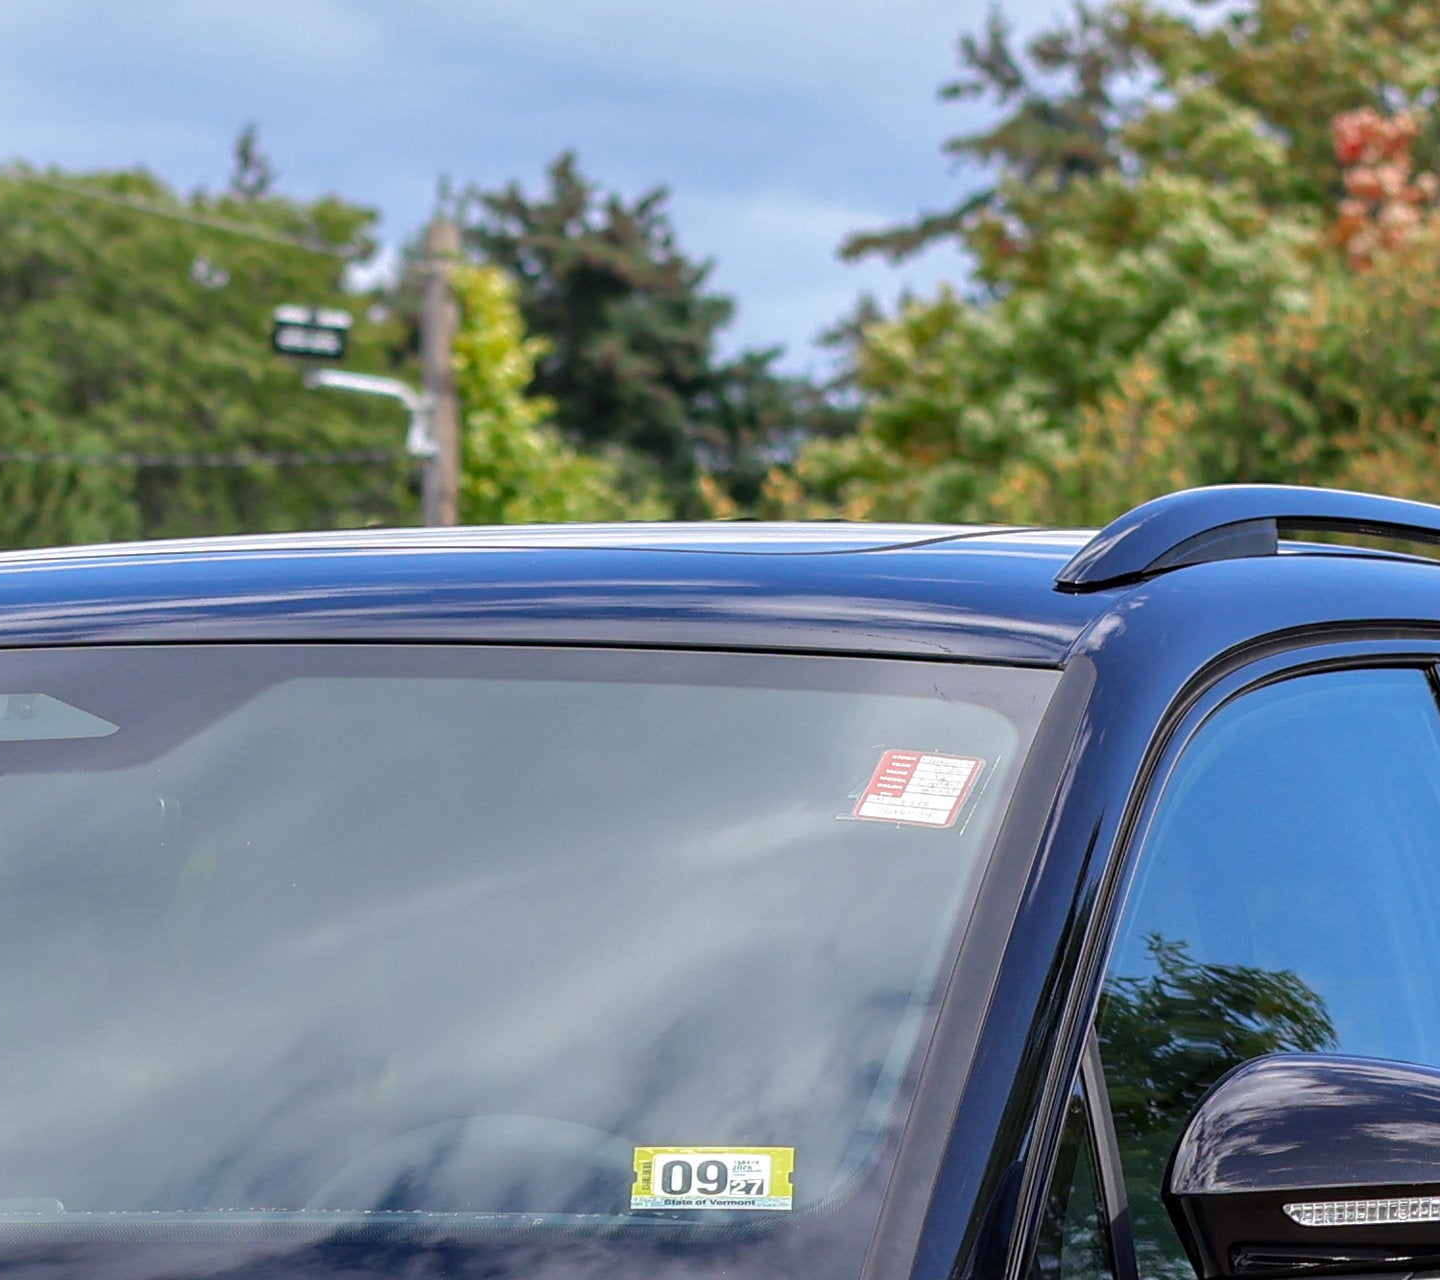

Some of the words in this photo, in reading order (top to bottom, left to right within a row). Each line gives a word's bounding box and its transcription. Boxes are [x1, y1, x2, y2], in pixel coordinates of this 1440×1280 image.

[661, 1159, 728, 1195] 09
[730, 1179, 764, 1196] 27
[664, 1198, 693, 1206] State
[695, 1198, 707, 1206] of
[709, 1198, 756, 1206] Vermont
